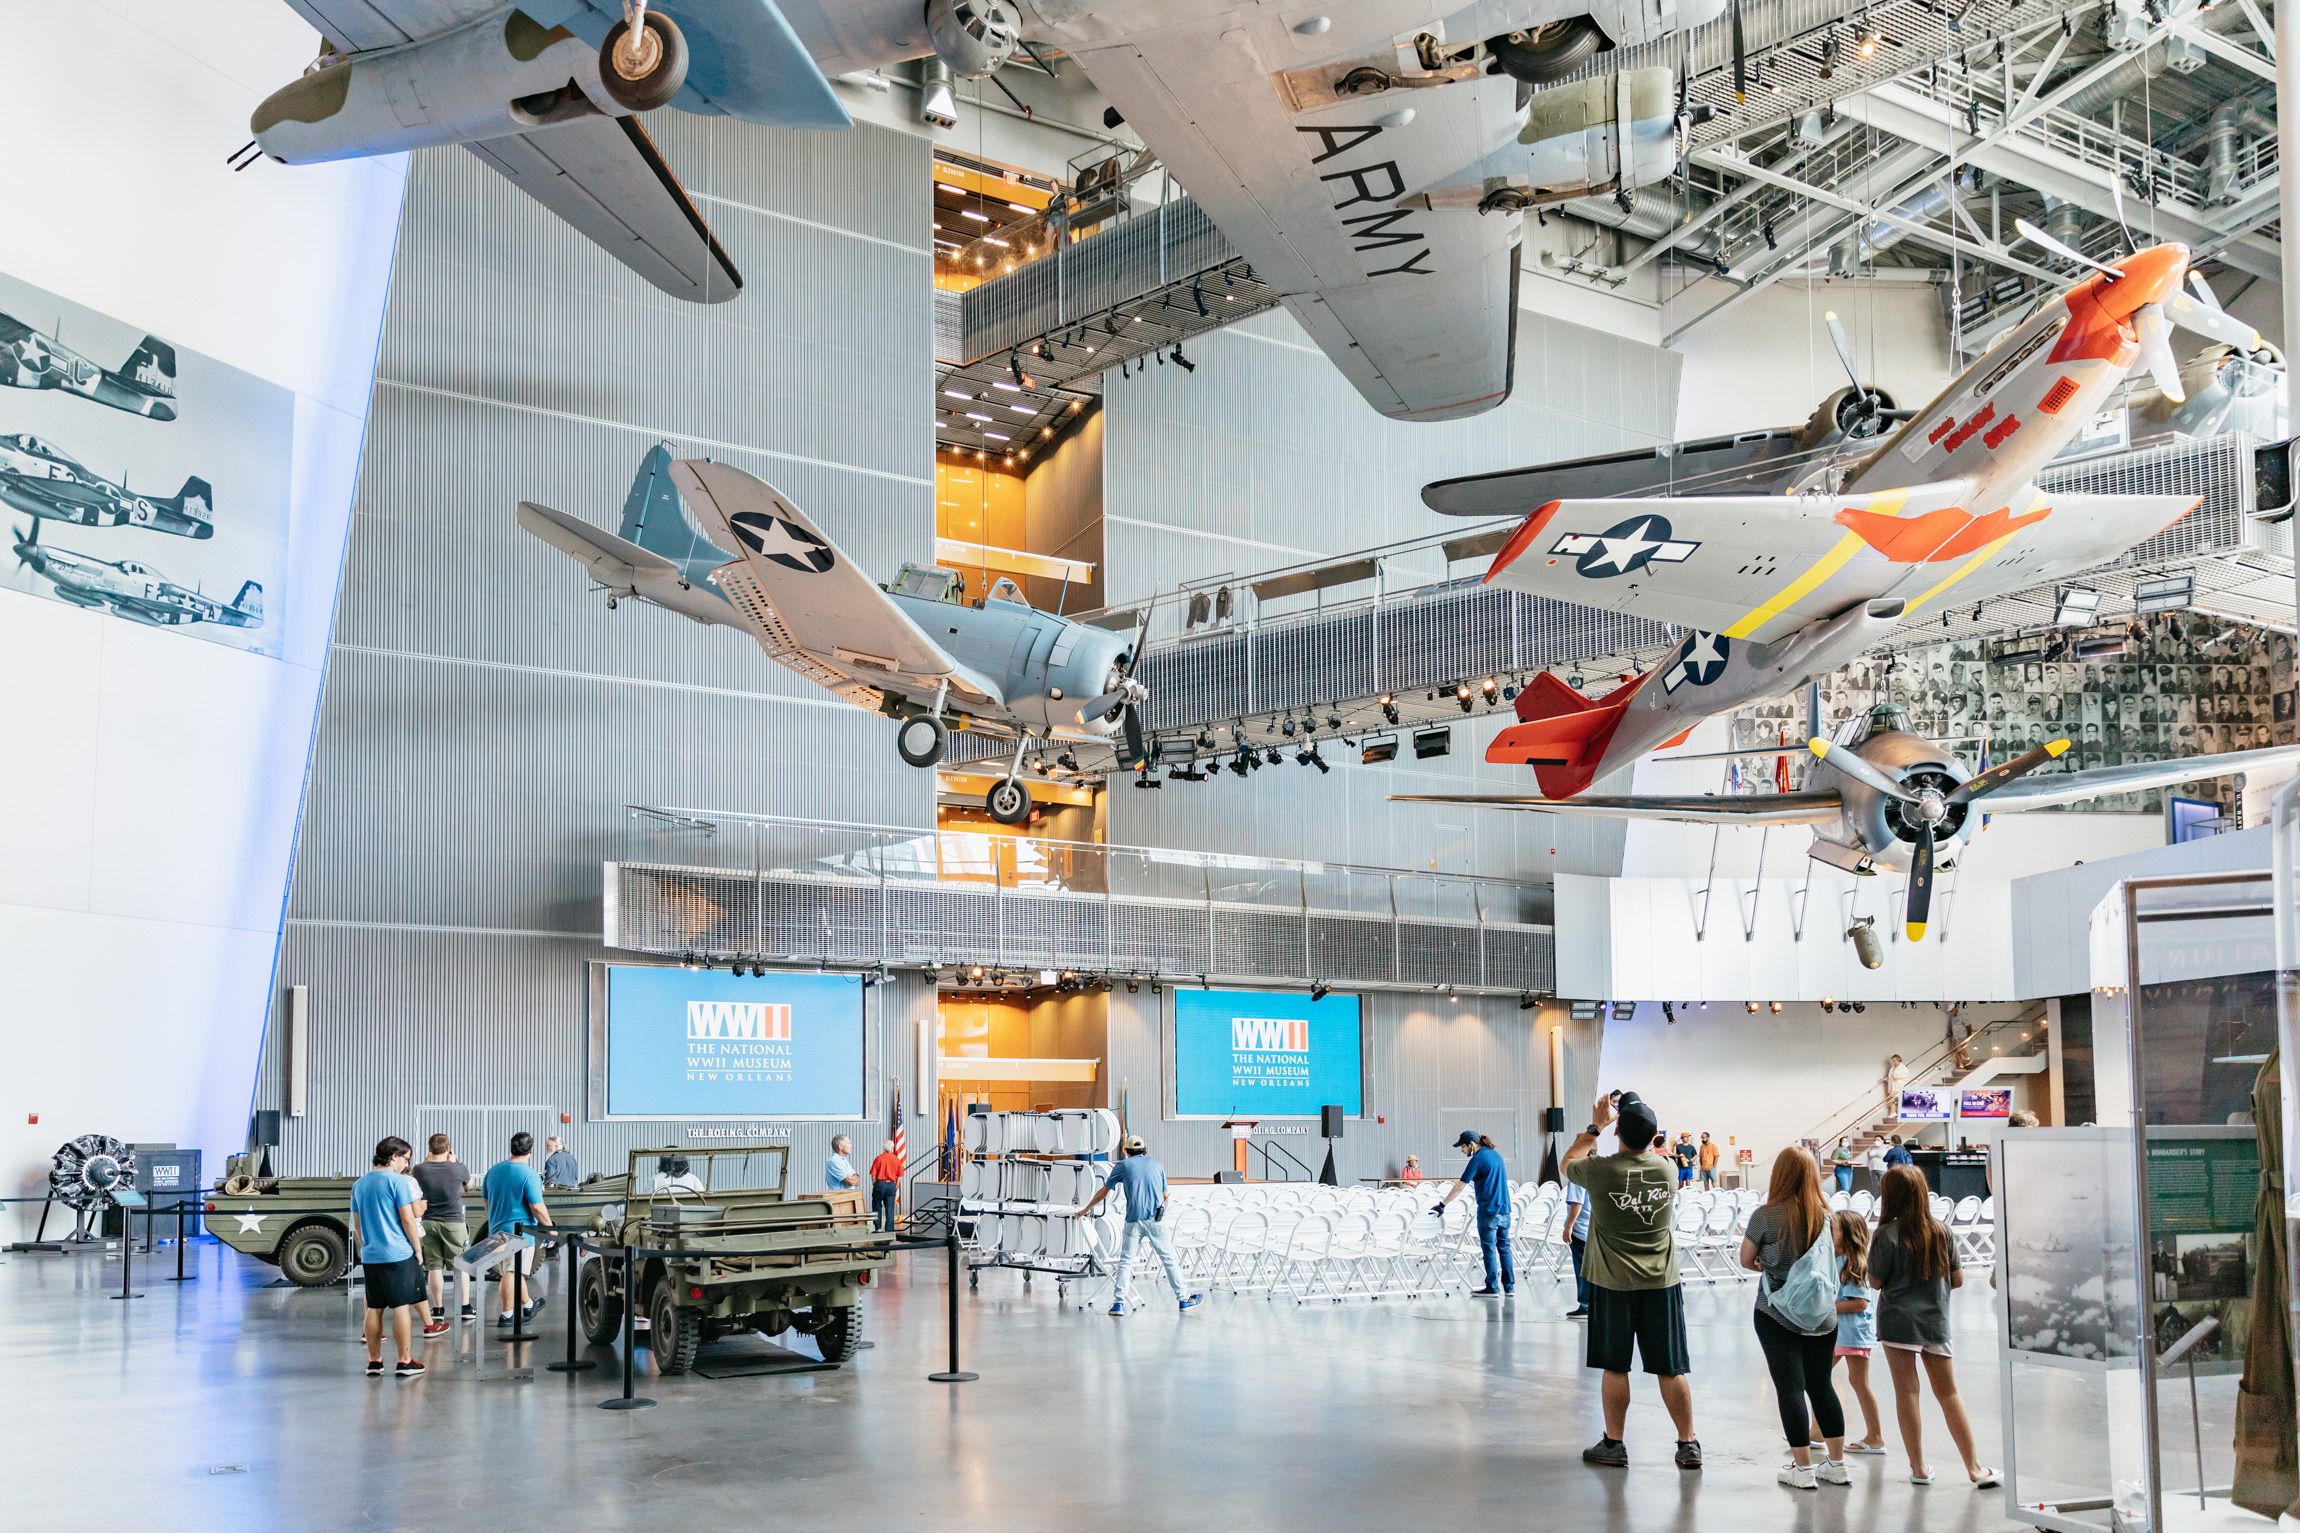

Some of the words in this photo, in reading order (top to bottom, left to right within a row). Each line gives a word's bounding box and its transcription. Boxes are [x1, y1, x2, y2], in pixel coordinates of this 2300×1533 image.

[943, 166, 965, 178] ELEVATOR
[1295, 125, 1437, 278] ARMY
[137, 500, 148, 521] S
[207, 604, 215, 620] A
[945, 775, 968, 783] ELEVATOR
[688, 1001, 791, 1041] WWII
[1232, 1017, 1309, 1052] WWII
[687, 1043, 715, 1054] THE
[720, 1044, 792, 1056] NATIONAL
[687, 1057, 726, 1068] WWII
[733, 1058, 791, 1069] MUSEUM
[1232, 1054, 1253, 1064] THE
[1256, 1054, 1309, 1065] NATIONAL
[687, 1072, 718, 1081] NEW
[725, 1073, 792, 1082] ORLEANS
[1232, 1066, 1261, 1075] WWII
[1266, 1066, 1309, 1076] MUSEUM
[1232, 1079, 1255, 1087] NEW
[1261, 1079, 1310, 1087] ORLEANS
[687, 1128, 704, 1138] THE
[708, 1128, 743, 1138] BOEING
[746, 1127, 792, 1138] COMPANY
[1250, 1126, 1275, 1135] OEING
[1277, 1126, 1310, 1135] COMPANY
[154, 1166, 178, 1176] WWII
[1619, 1190, 1643, 1207] Del
[1647, 1188, 1668, 1202] Rio
